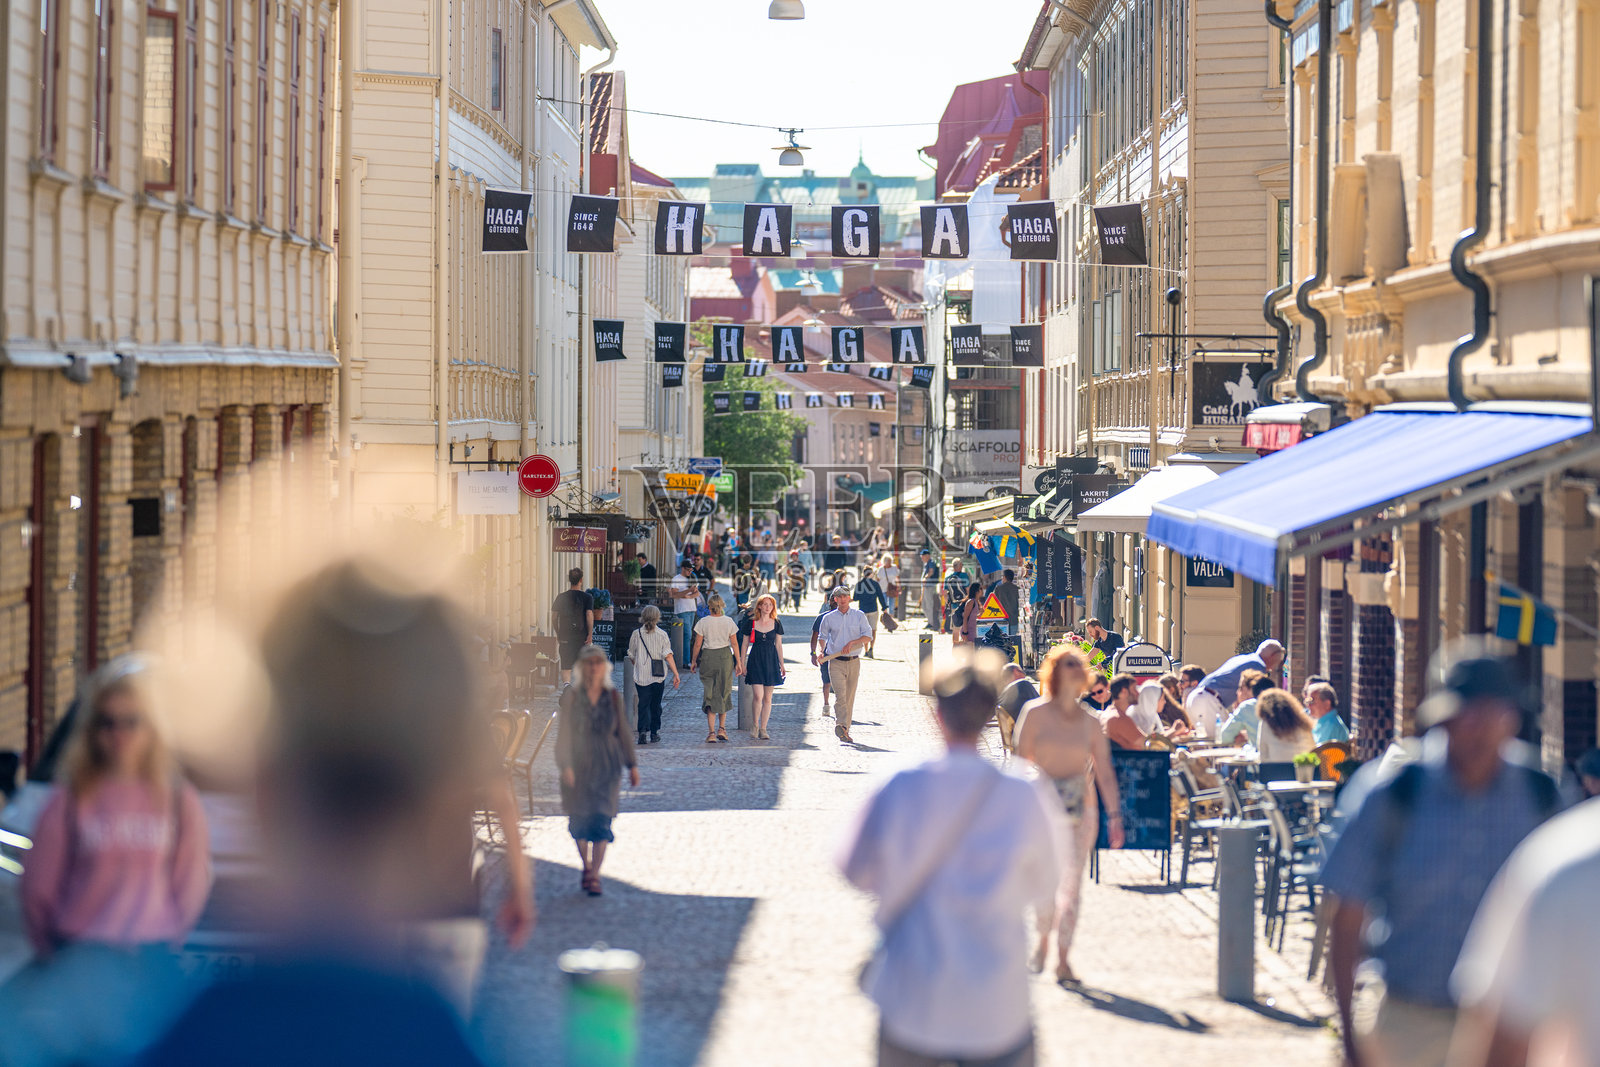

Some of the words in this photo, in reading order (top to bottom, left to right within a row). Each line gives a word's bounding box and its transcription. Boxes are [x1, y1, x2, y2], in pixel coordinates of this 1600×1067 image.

[486, 208, 523, 225] HAGA
[574, 213, 598, 221] SINCE
[488, 225, 519, 234] GÖTEBORG
[573, 222, 594, 231] 1648
[666, 205, 696, 253] H
[752, 207, 783, 253] A
[842, 208, 870, 256] G
[930, 207, 961, 255] A
[1012, 217, 1054, 234] HAGA
[1103, 226, 1126, 235] SINCE
[1017, 233, 1050, 242] GÖTEBORG
[596, 332, 620, 344] HAGA
[953, 336, 980, 348] HAGA
[720, 328, 739, 362] H
[779, 328, 801, 361] A
[838, 328, 858, 362] G
[898, 328, 920, 362] A
[1202, 404, 1228, 415] Café
[951, 442, 1020, 453] SCAFFOLD
[468, 485, 482, 494] TELL
[483, 485, 492, 494] ME
[494, 485, 510, 494] MORE
[1064, 547, 1072, 569] Design
[1193, 562, 1224, 578] VALLA
